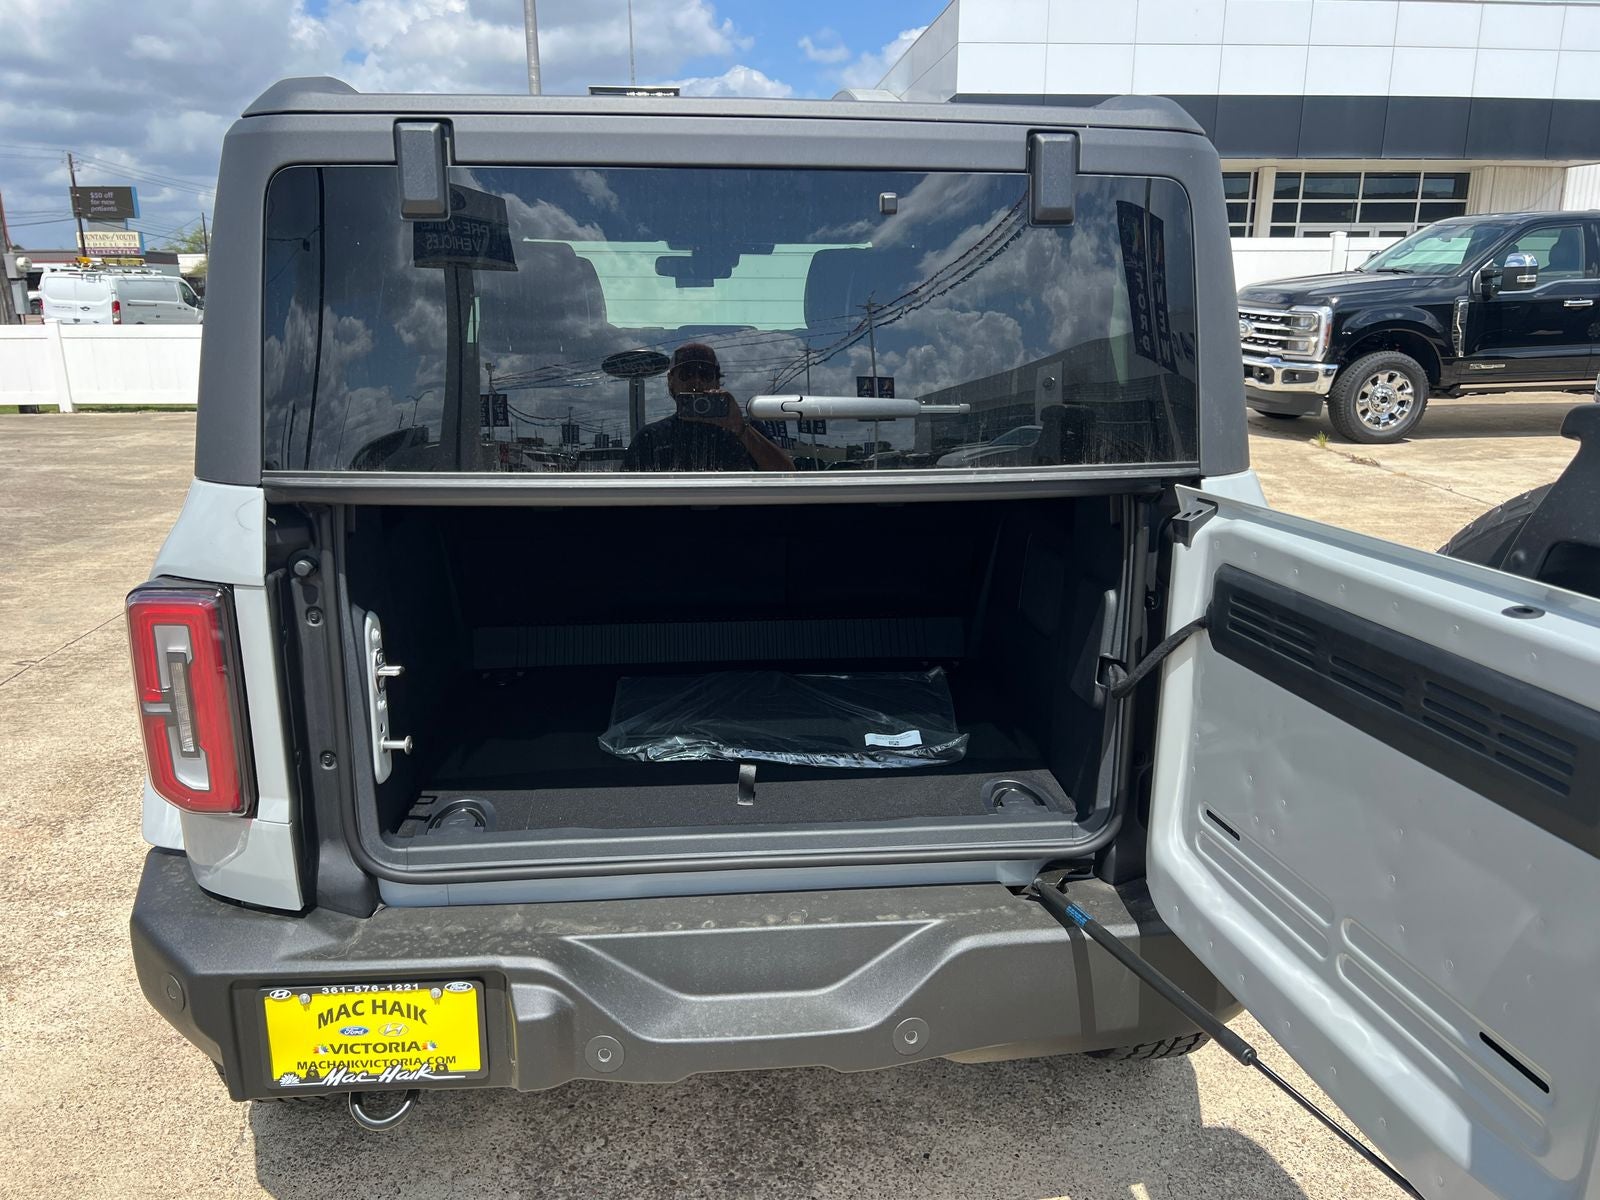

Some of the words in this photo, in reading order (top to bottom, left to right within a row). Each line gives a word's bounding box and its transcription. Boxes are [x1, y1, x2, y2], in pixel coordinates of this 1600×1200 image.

[322, 983, 419, 994] 361-576-1221
[447, 983, 471, 991] Ford
[318, 1000, 365, 1029] MAC
[371, 999, 428, 1025] HAIK
[342, 1026, 366, 1036] Ford
[329, 1041, 422, 1055] VICTORIA
[323, 1067, 376, 1086] Mac
[378, 1063, 434, 1083] Haik
